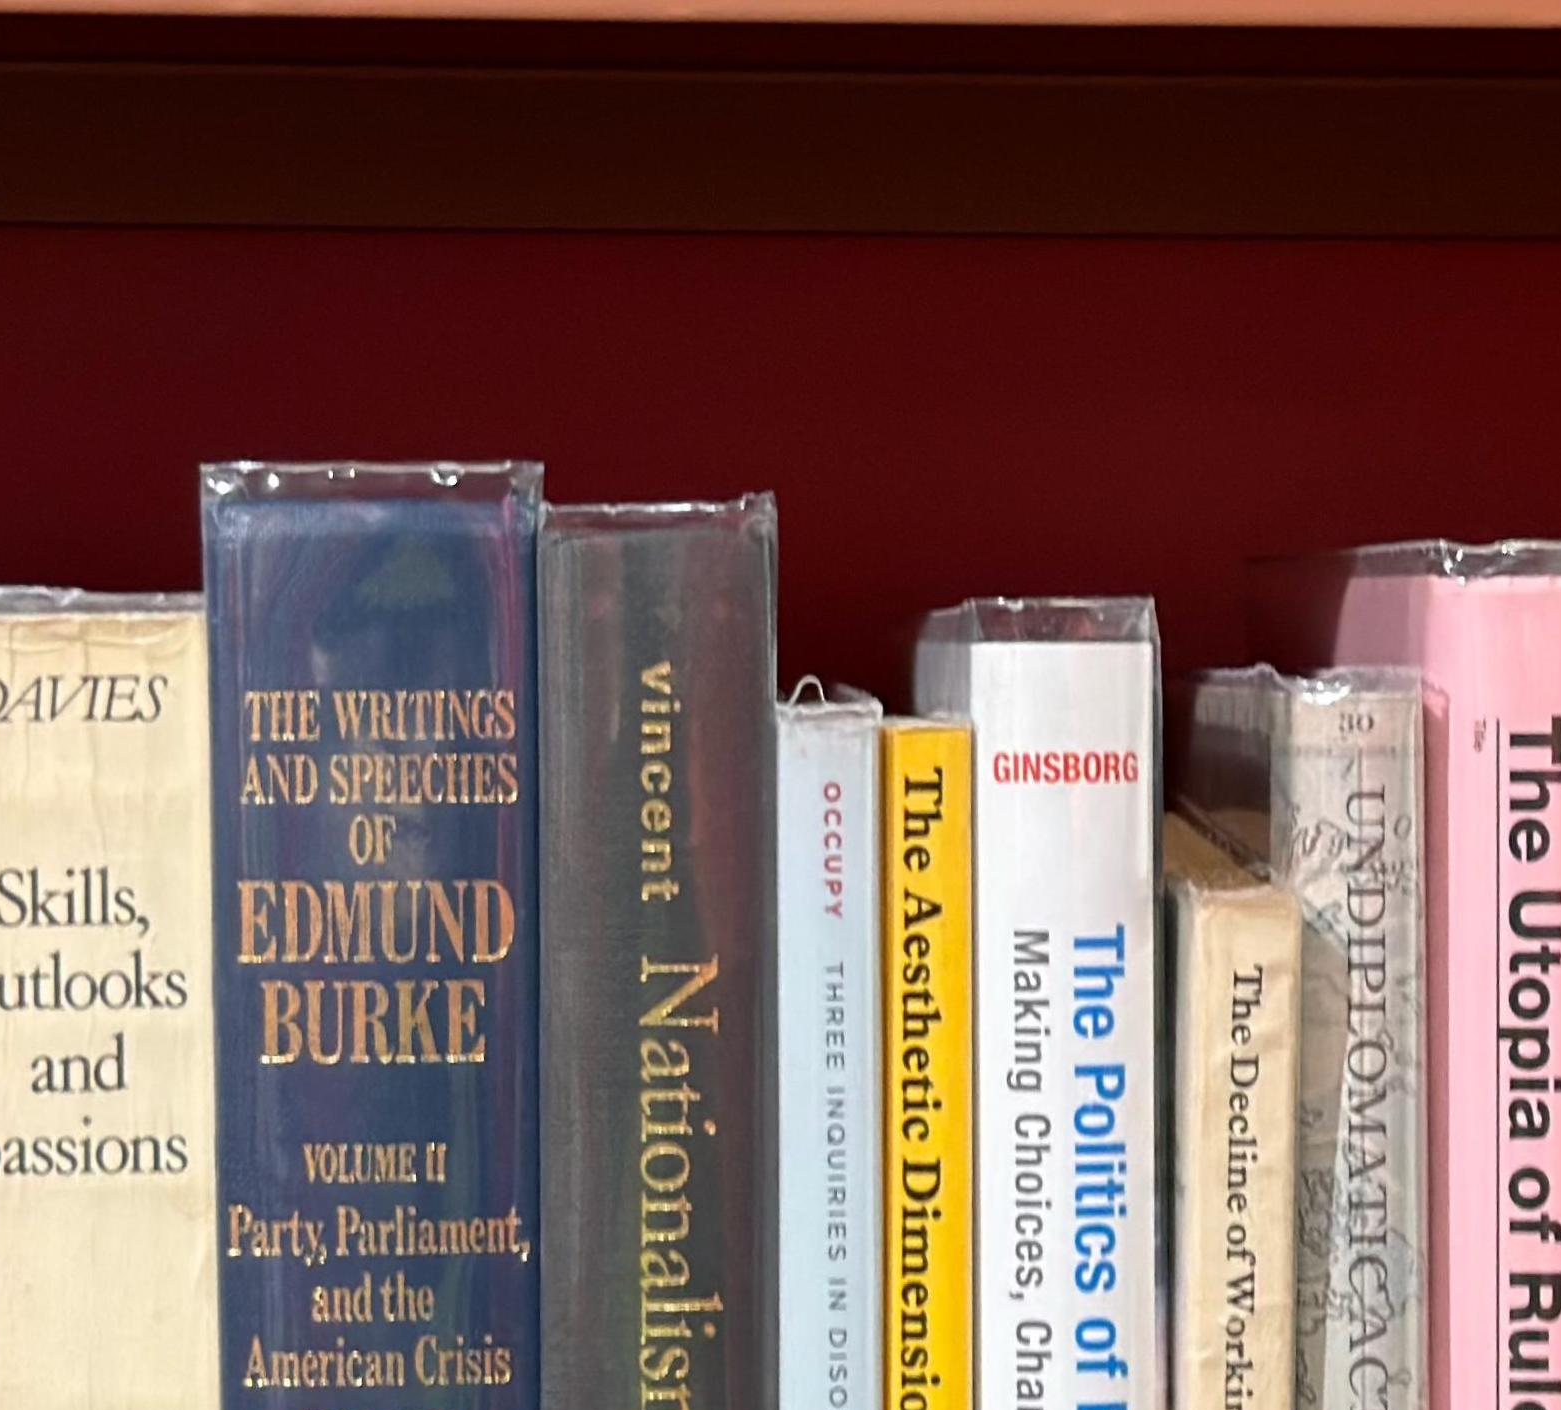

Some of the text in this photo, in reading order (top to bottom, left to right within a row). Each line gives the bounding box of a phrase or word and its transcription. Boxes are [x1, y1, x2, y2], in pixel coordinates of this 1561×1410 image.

[333, 690, 516, 741] WRITINGS
[330, 753, 518, 804] SPEECHES
[904, 766, 942, 871] The
[993, 752, 1139, 785] GINSBORG
[823, 781, 842, 918] OCCUPY
[237, 880, 516, 964] EDMUND
[260, 979, 486, 1065] BURKE
[825, 962, 845, 1070] THREE
[903, 890, 942, 1143] Aesthetic
[1007, 930, 1050, 1093] Making
[1073, 923, 1125, 1039] The
[1230, 963, 1263, 1048] The
[31, 1033, 126, 1094] and
[1347, 786, 1388, 1293] UNDIPLOMATIC
[302, 1143, 416, 1183] VOLUME
[826, 1086, 847, 1262] INQUIRIES
[1073, 1064, 1127, 1294] Politics
[1226, 1057, 1259, 1209] Decline
[336, 1204, 531, 1262] Parliament,
[1008, 1112, 1052, 1301] Choices,
[243, 1335, 512, 1387] American Crisis
